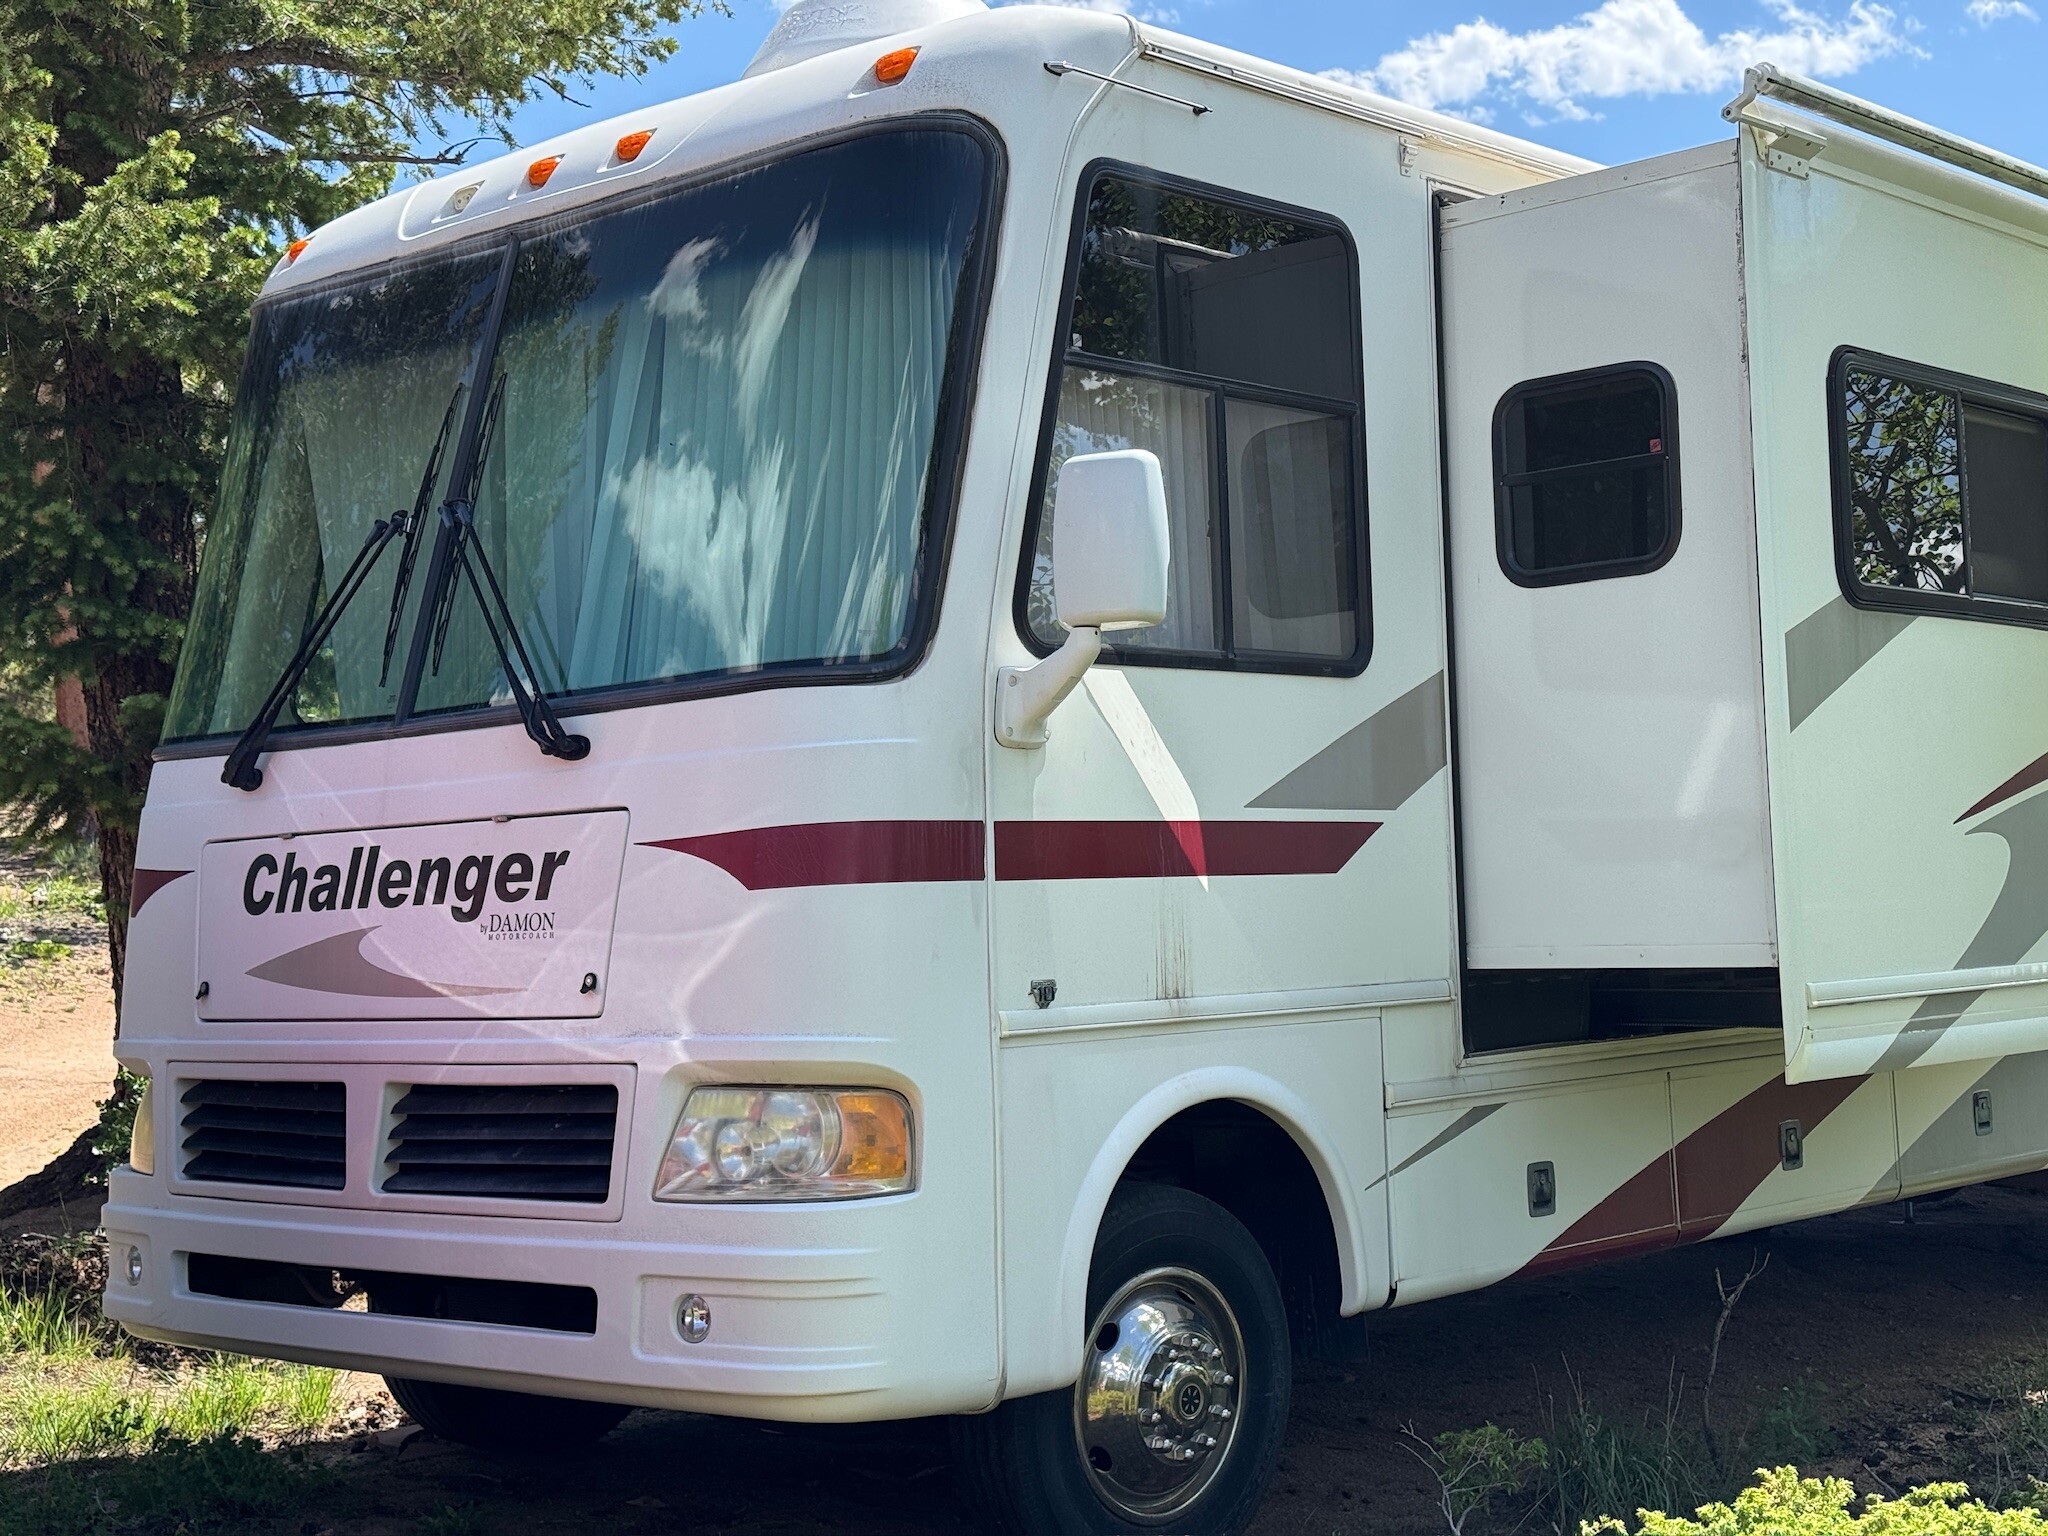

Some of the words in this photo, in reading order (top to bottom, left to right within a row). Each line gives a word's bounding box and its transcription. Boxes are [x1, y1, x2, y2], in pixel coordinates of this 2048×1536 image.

[243, 845, 570, 923] Challenger
[480, 923, 489, 935] by
[489, 912, 556, 933] DAMON
[488, 931, 555, 941] MOTORCOACH
